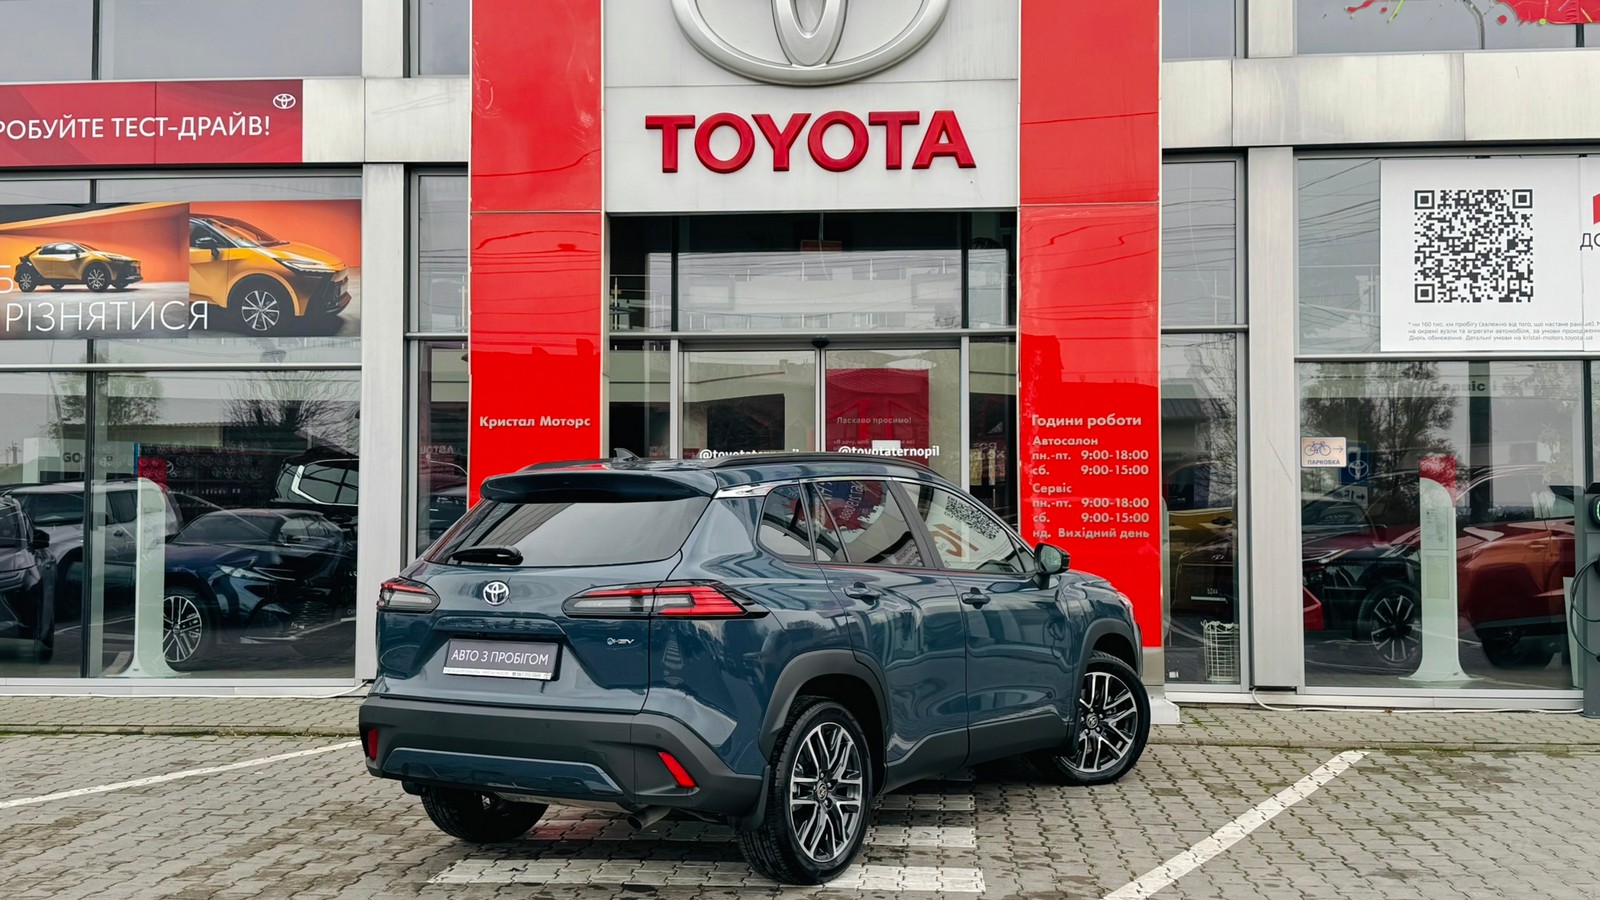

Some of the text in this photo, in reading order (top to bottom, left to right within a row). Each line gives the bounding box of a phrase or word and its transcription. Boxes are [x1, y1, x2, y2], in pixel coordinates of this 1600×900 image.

[111, 111, 270, 140] ТЕСТ-ДРАЙВ!
[645, 110, 977, 174] TOYOTA
[6, 300, 209, 332] РІЗНЯТИСЯ
[479, 416, 591, 429] Кристал Моторс
[836, 416, 912, 425] Ласкаво просимо!
[1031, 413, 1142, 429] Години роботи
[1032, 435, 1099, 446] Автосалон
[1032, 449, 1149, 460] пн.-пт. 9:00-18:00
[1032, 464, 1149, 475] сб. 9:00-15:00
[1032, 482, 1072, 496] Сервіс
[1032, 497, 1150, 508] пн.-пт. 9:00-18:00
[1033, 512, 1150, 523] сб. 9:00-15:00
[1032, 527, 1150, 539] нд. Вихідний день
[451, 649, 550, 666] АВТО З ПРОБІГОМ
